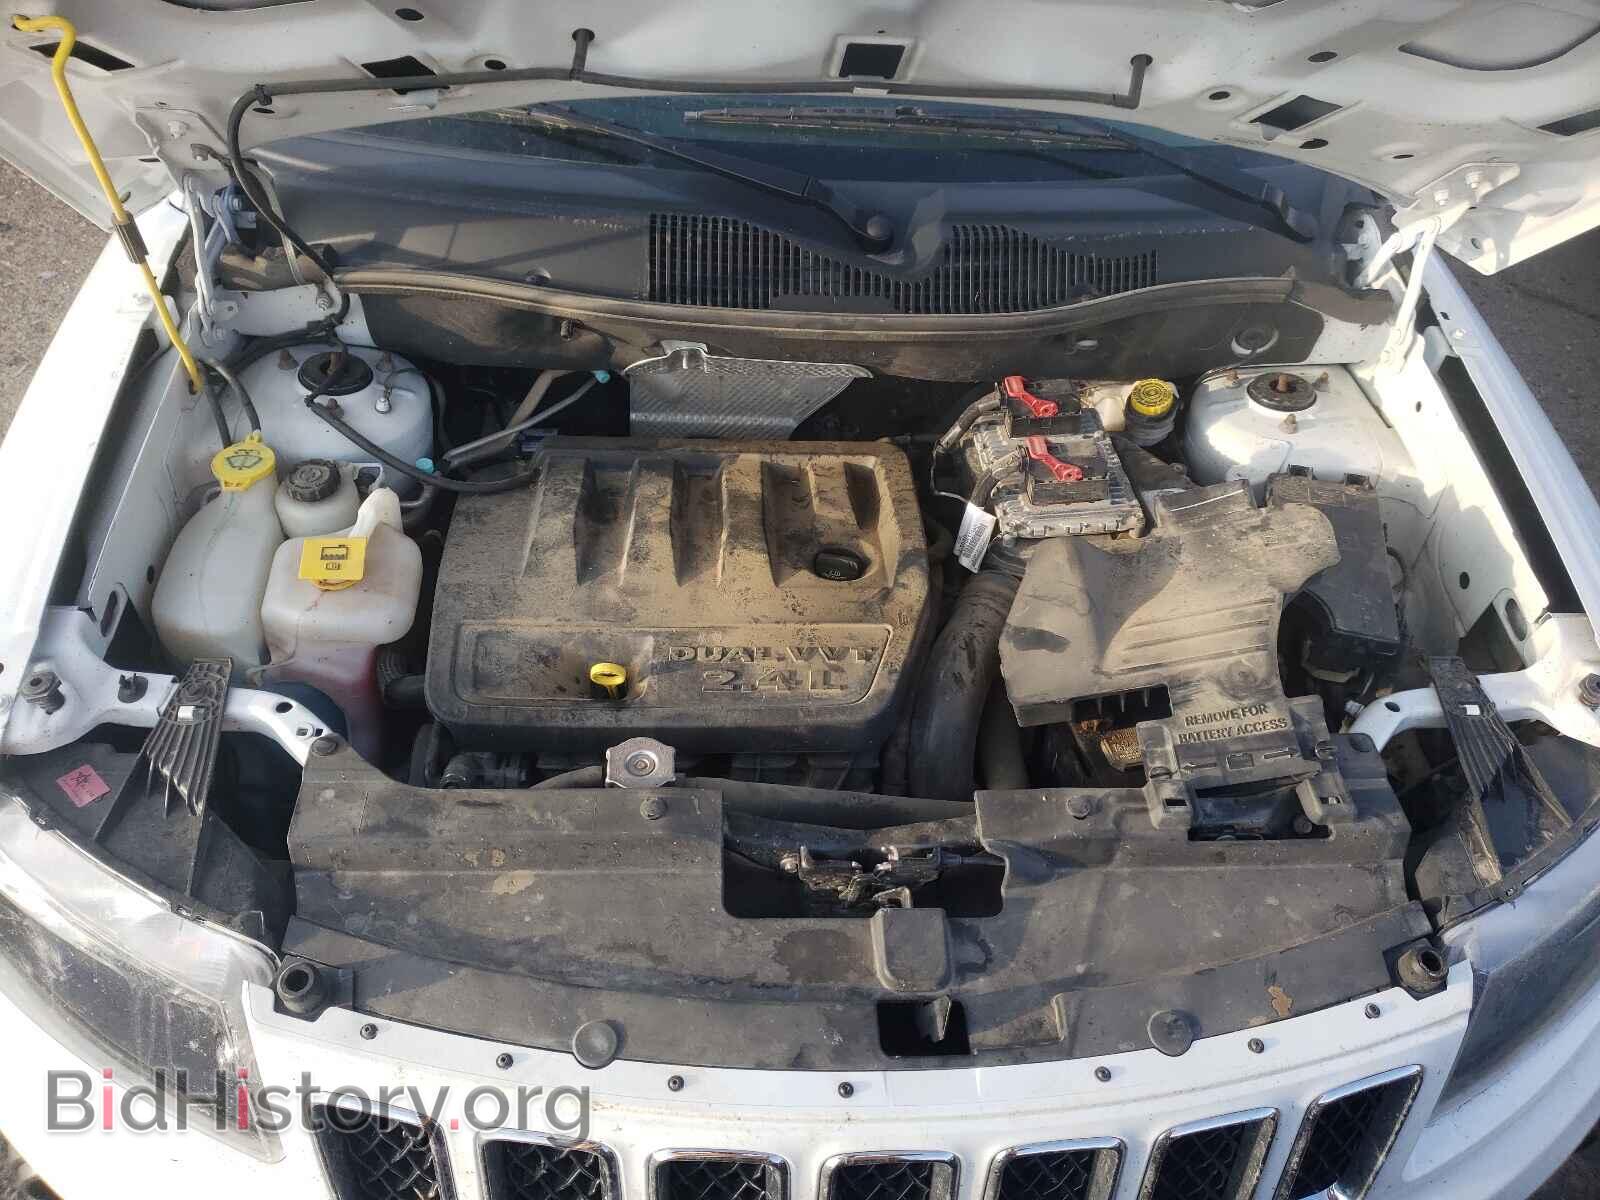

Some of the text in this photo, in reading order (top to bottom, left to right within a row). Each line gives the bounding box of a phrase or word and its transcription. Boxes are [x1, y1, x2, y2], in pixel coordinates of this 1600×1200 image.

[669, 646, 785, 664] DUAL
[701, 669, 848, 693] 2.4L
[1184, 702, 1269, 727] REMOVE FOR
[1178, 717, 1288, 744] BATTERY ACCESS
